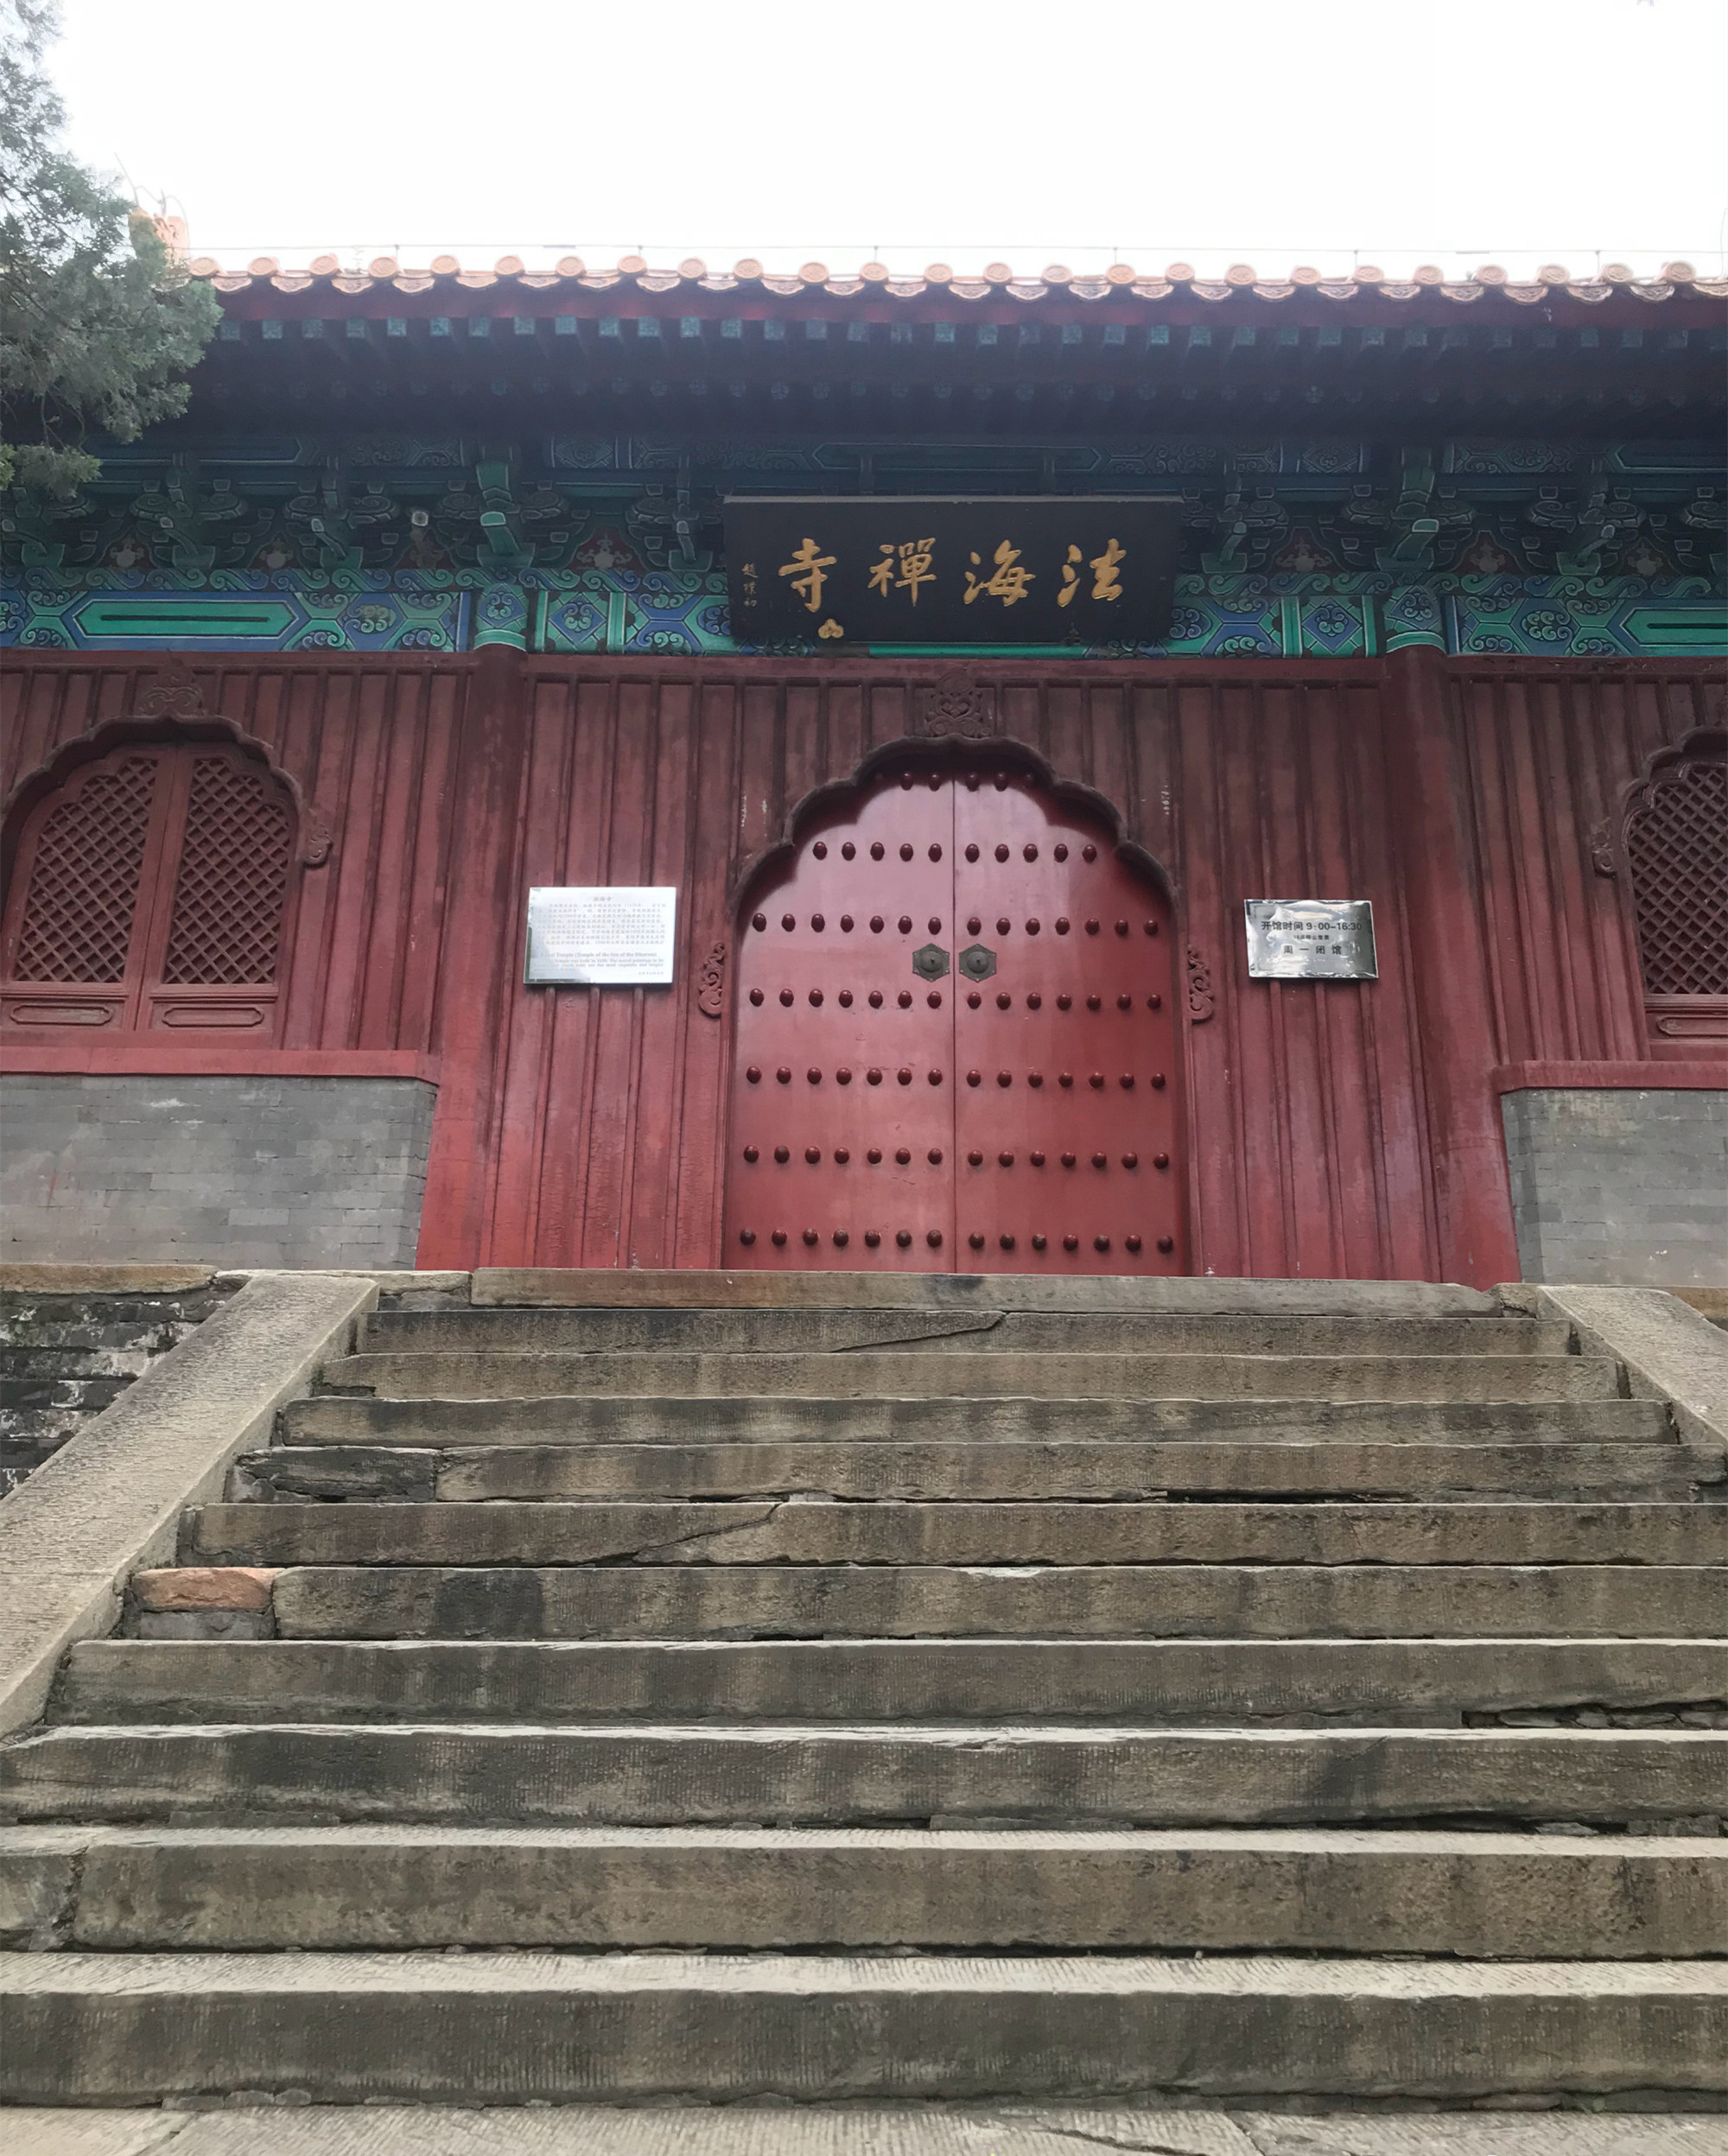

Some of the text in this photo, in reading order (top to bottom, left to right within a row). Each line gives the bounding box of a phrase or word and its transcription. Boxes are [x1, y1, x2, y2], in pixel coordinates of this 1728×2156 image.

[778, 537, 1128, 614] 法海禪寺
[1261, 921, 1303, 931] 开馆时间
[1283, 945, 1342, 955] 周一闭馆
